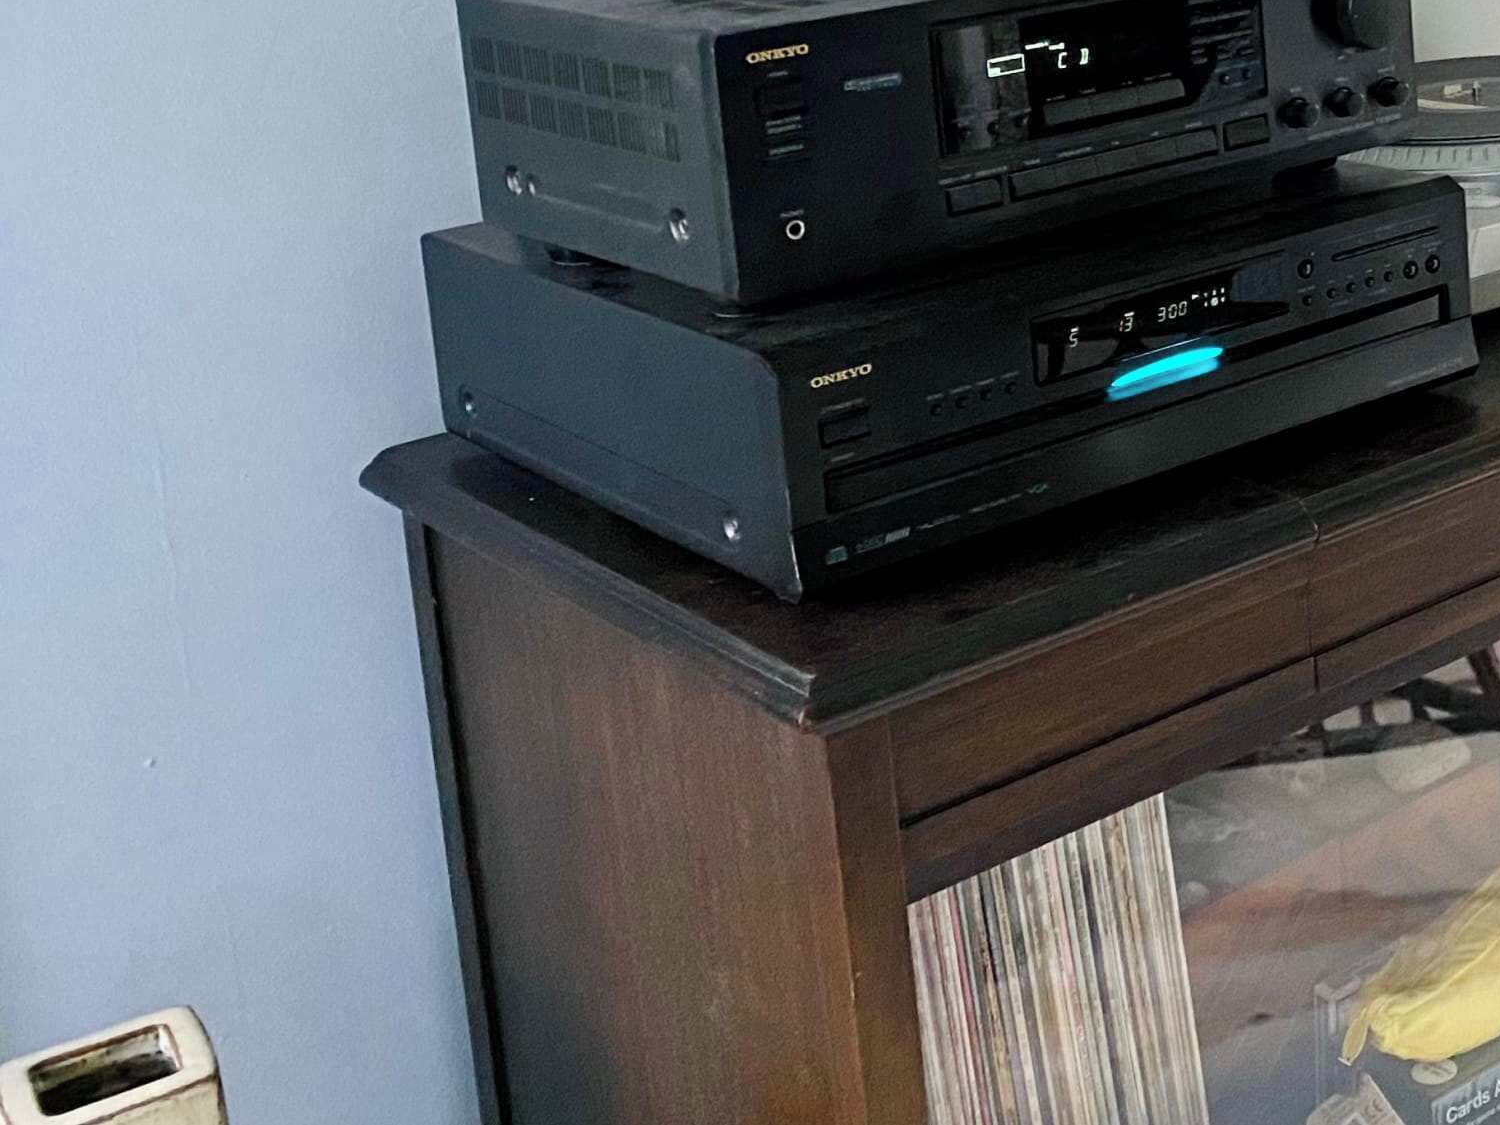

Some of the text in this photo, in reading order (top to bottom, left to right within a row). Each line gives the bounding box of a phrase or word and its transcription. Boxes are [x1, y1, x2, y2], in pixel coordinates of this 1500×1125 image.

[745, 43, 809, 64] ONKYO
[1157, 300, 1188, 323] 300
[810, 363, 872, 388] ONKYO
[1446, 1090, 1490, 1124] Cards
